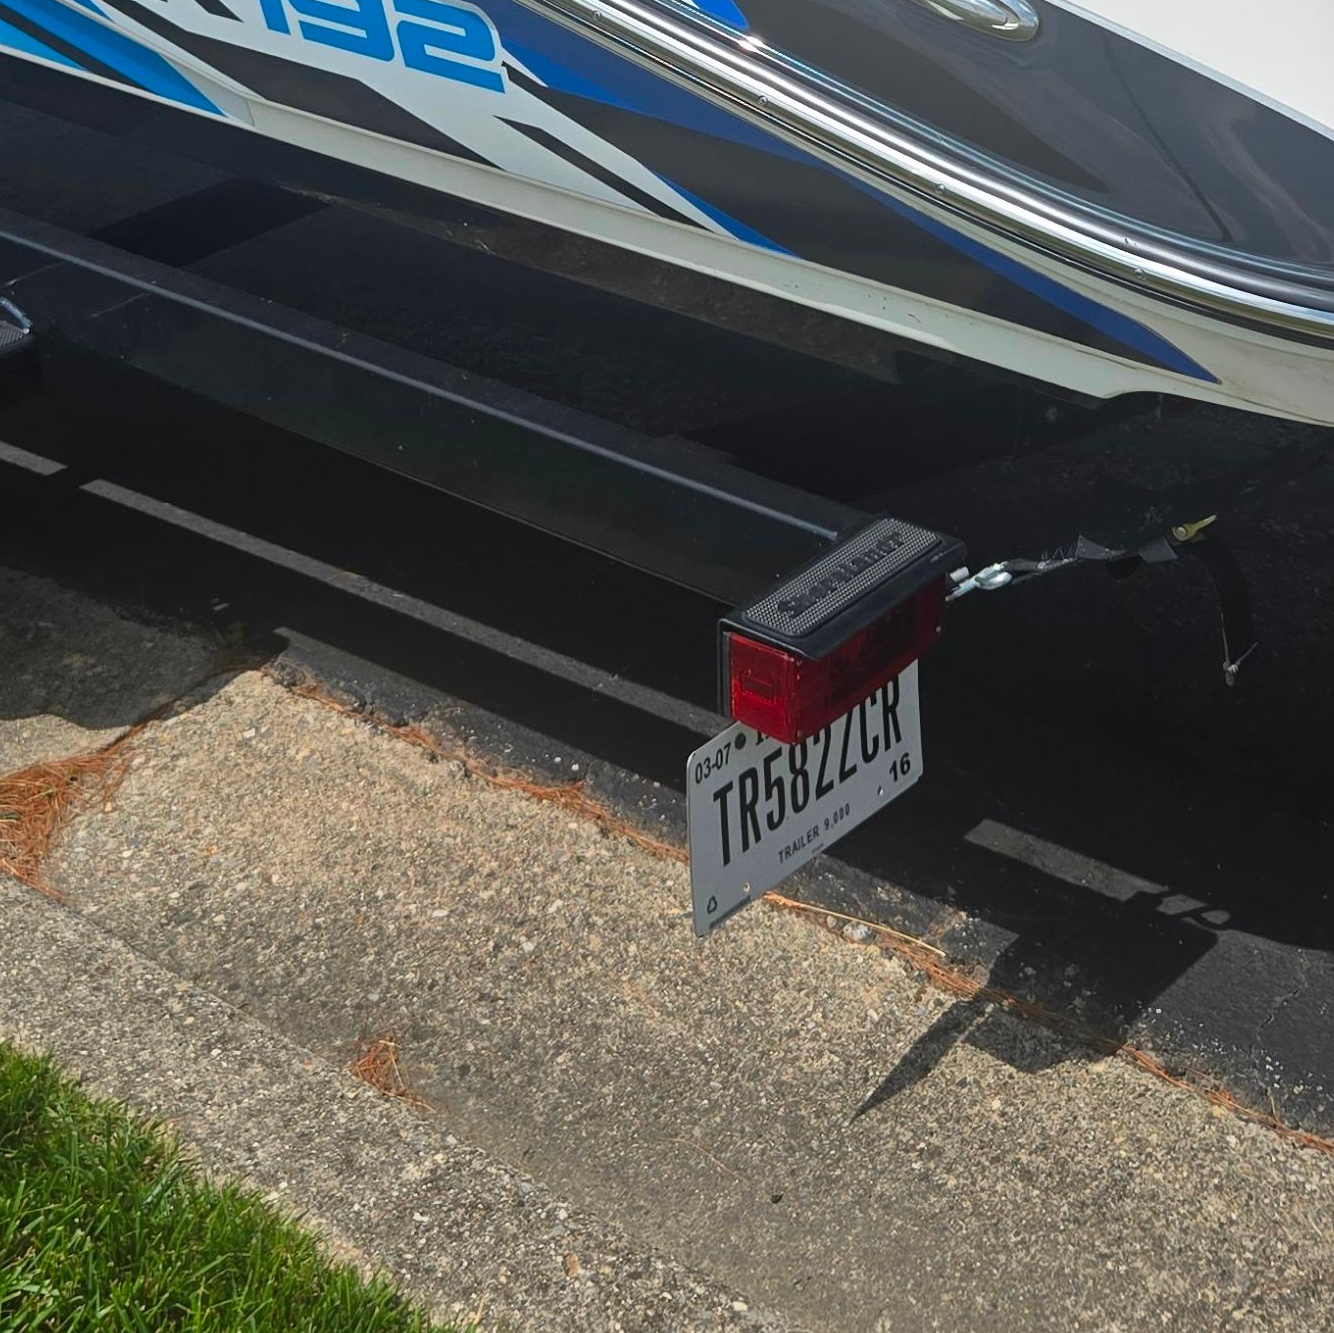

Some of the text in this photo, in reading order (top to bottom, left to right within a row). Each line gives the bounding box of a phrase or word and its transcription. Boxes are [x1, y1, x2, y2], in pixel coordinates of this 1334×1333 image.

[694, 741, 732, 785] 03-07
[888, 751, 911, 783] 16
[778, 801, 851, 864] TRAILER 9,000
